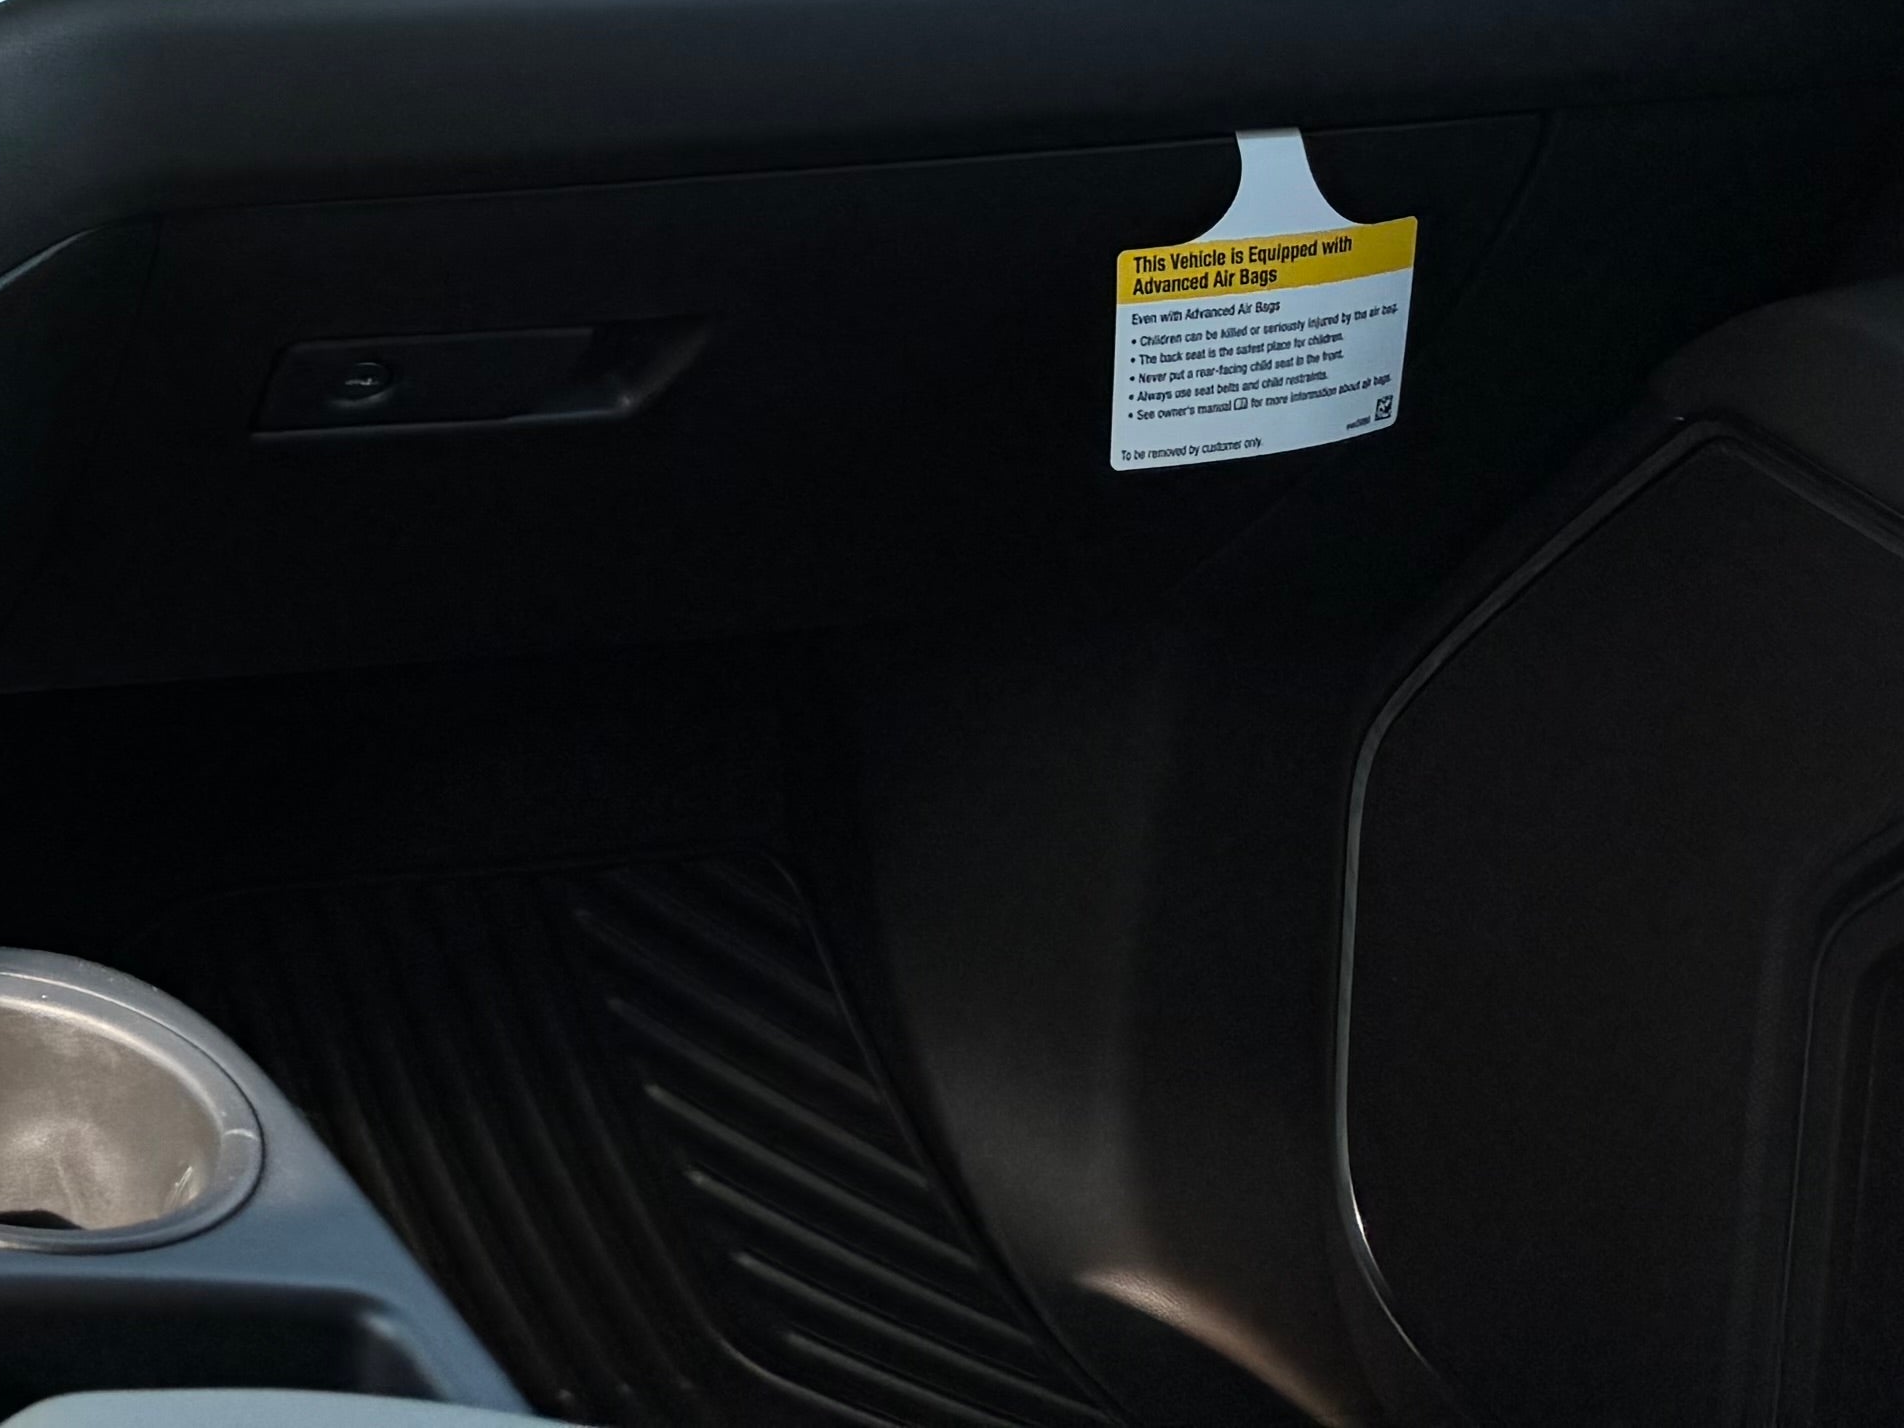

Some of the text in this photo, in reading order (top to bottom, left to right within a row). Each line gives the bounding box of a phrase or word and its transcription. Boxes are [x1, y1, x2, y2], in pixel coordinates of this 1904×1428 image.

[1133, 235, 1353, 274] This Vehicle is Equipped with
[1133, 268, 1278, 295] Advanced Air Bags
[1131, 300, 1281, 326] Even with Advanced Air Bags
[1140, 332, 1182, 347] Children
[1184, 331, 1203, 343] can
[1205, 329, 1218, 341] be
[1249, 325, 1261, 336] or
[1263, 318, 1306, 334] seriously
[1341, 312, 1352, 326] by
[1139, 353, 1157, 365] The
[1159, 351, 1183, 364] back
[1185, 349, 1206, 361] seat
[1208, 347, 1216, 358] is
[1218, 345, 1234, 357] the
[1235, 342, 1264, 355] safest
[1267, 339, 1292, 353] place
[1293, 336, 1306, 348] for
[1121, 450, 1132, 462] To
[1134, 448, 1146, 460] be
[1147, 445, 1187, 458] removed
[1189, 443, 1201, 456] by
[1202, 440, 1242, 454] customer
